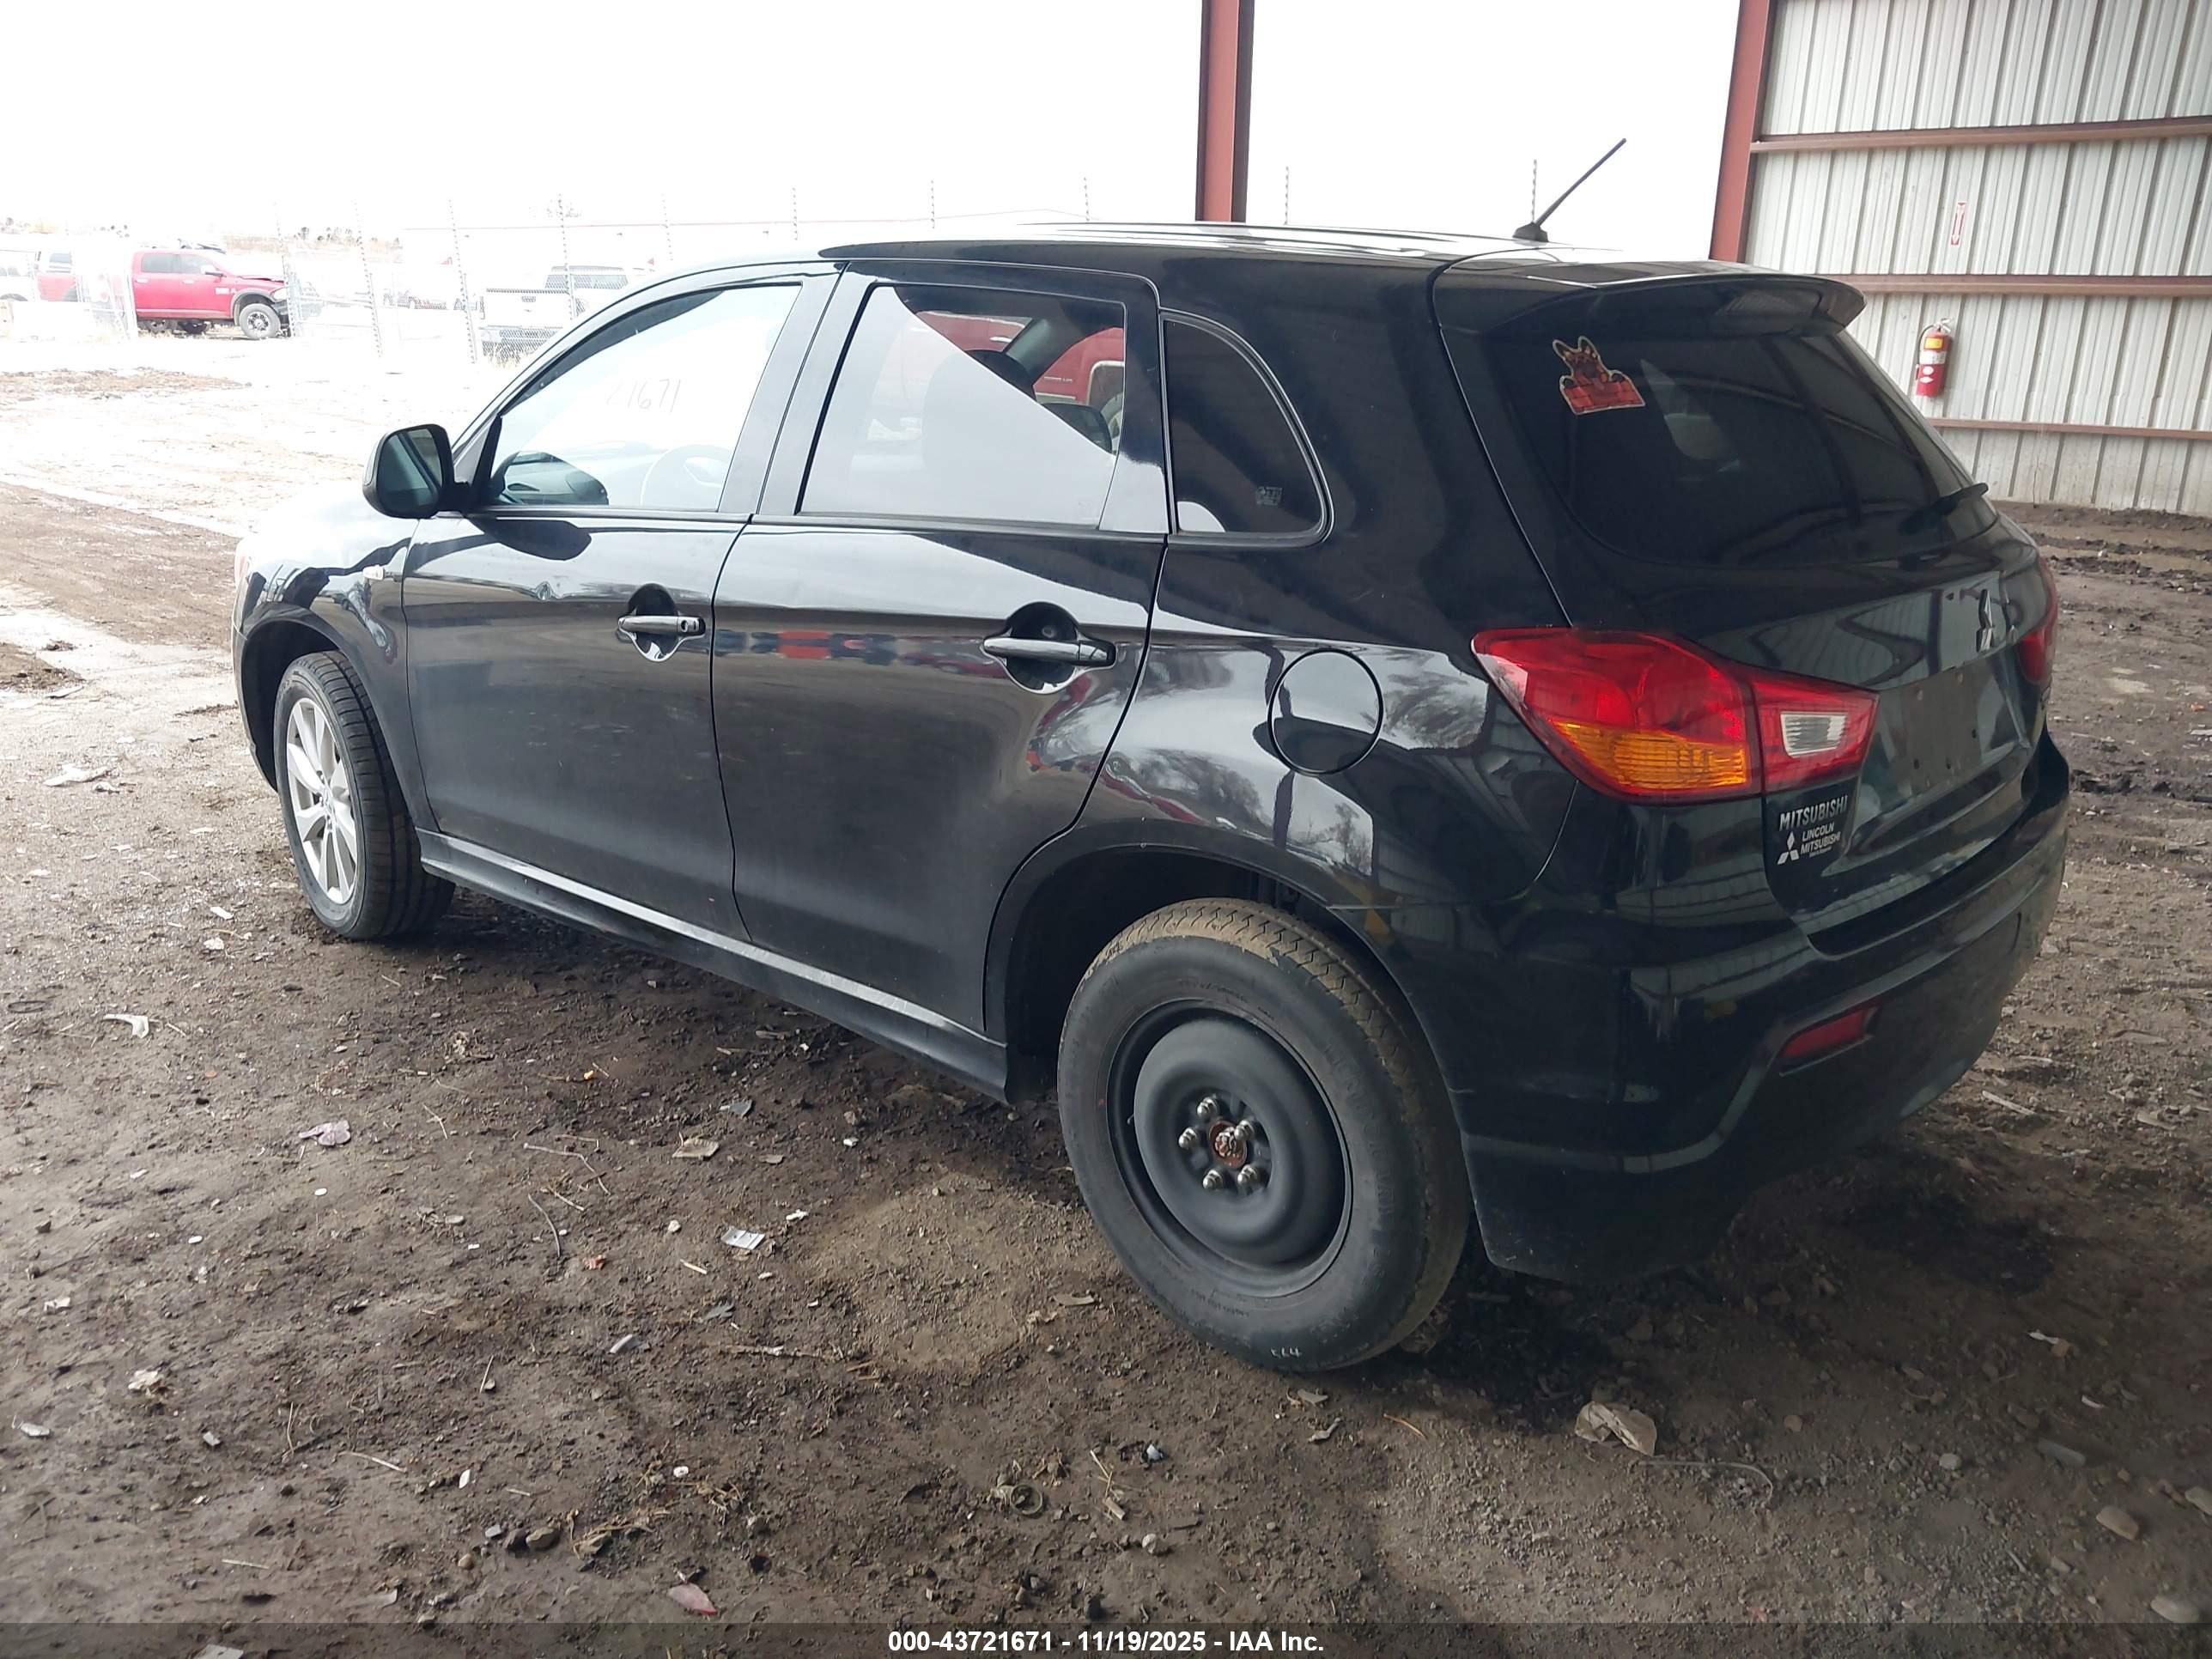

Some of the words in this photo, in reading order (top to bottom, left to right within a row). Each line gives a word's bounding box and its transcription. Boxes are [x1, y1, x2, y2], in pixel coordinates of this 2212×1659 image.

[1779, 795, 1848, 830] MITSUBISHI
[1800, 831, 1841, 855] MITSUBISHI
[1802, 822, 1834, 842] LINCOLN
